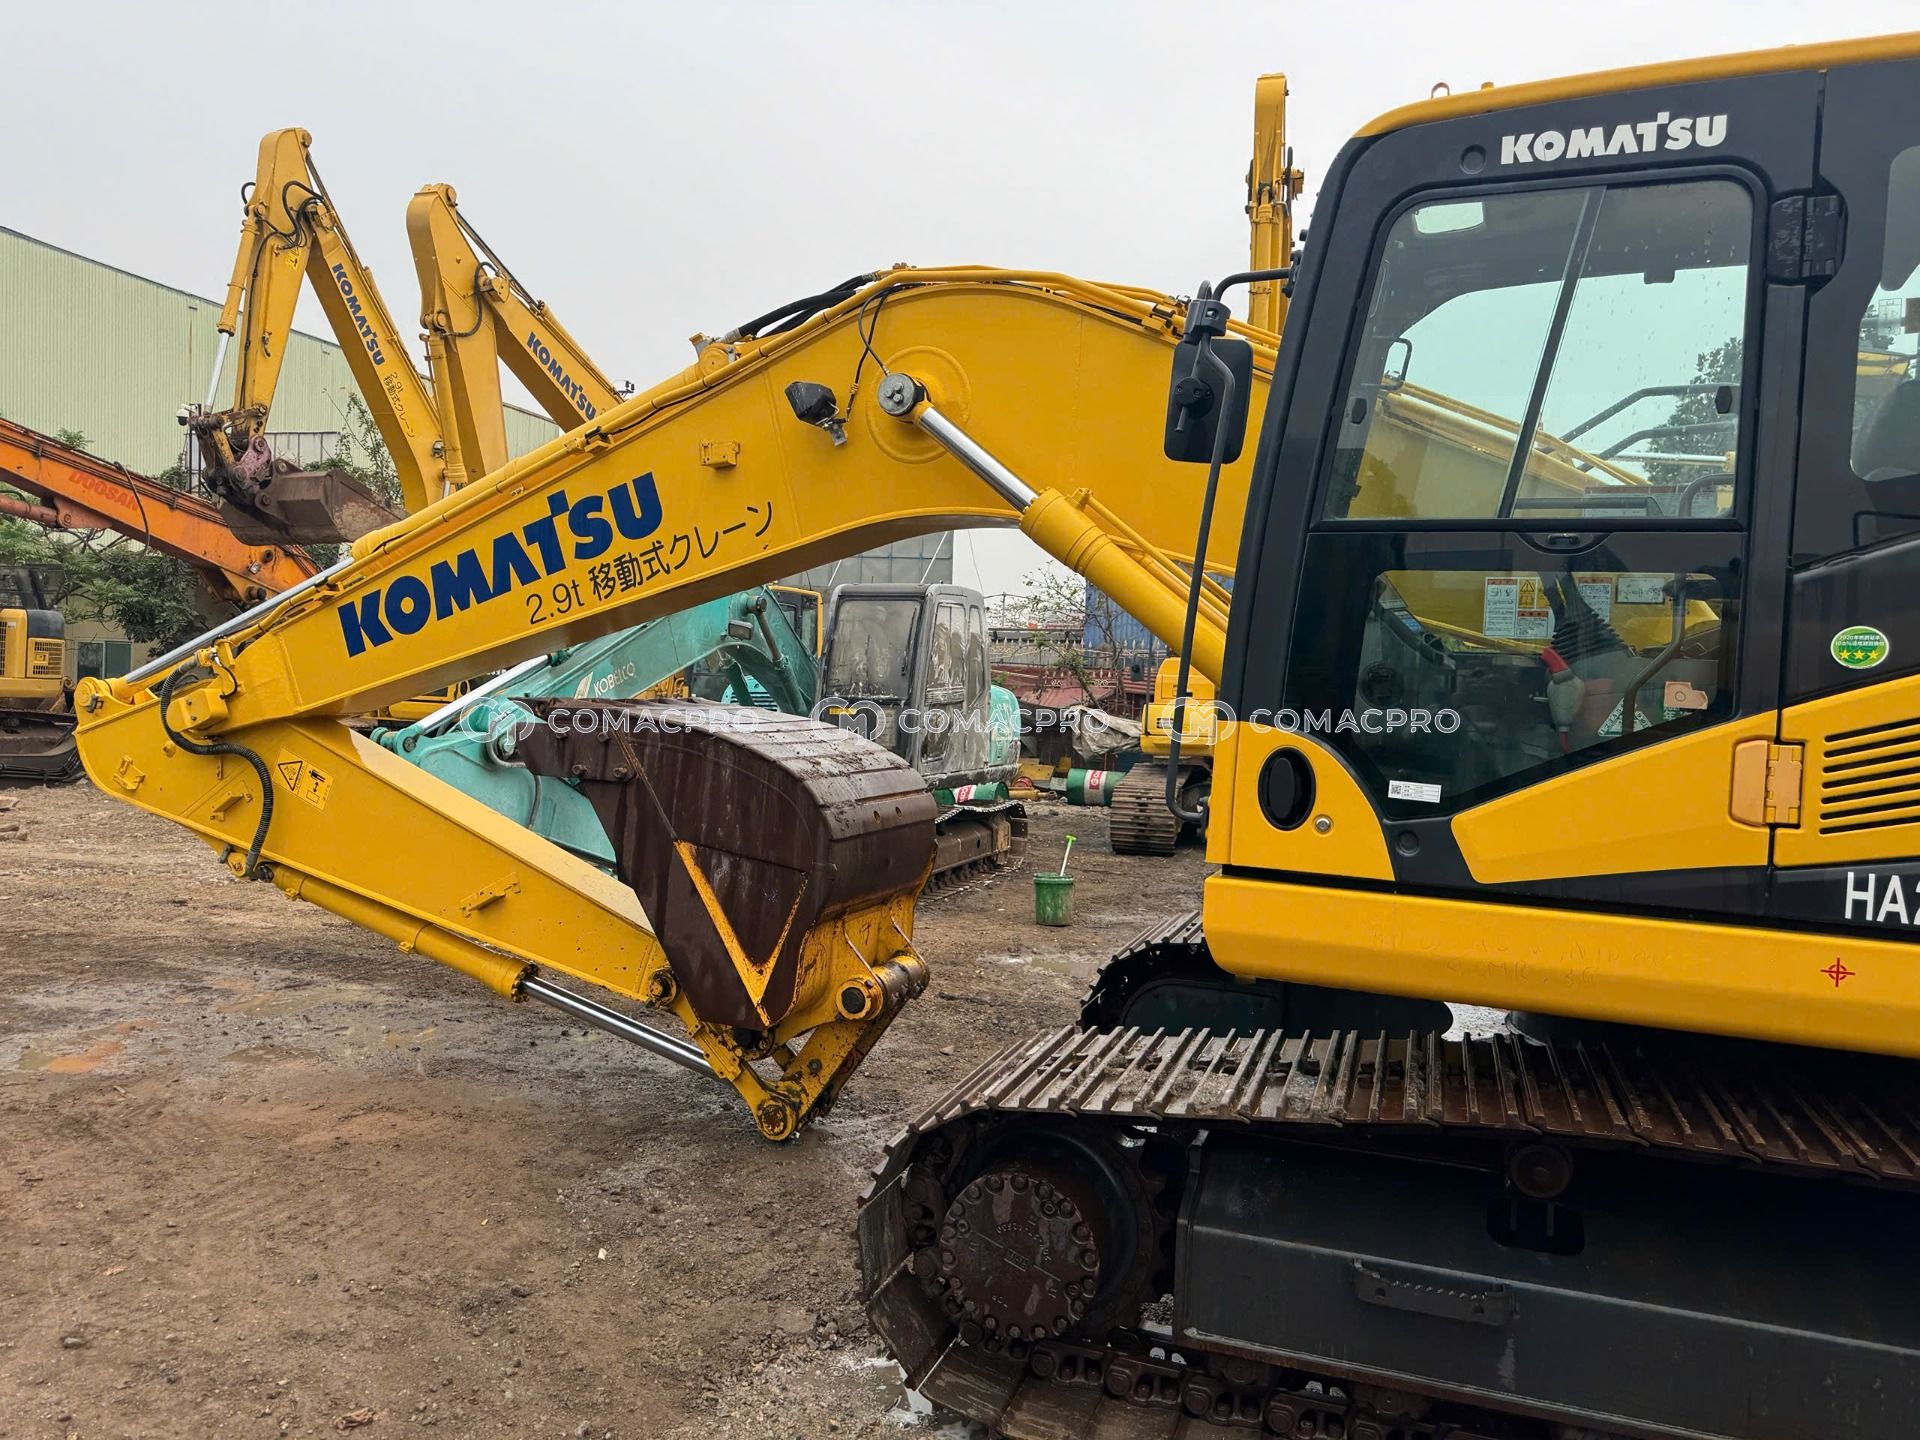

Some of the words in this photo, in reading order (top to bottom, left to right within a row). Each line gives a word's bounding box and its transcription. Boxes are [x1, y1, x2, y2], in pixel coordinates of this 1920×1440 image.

[1500, 111, 1728, 165] KOMATSU
[331, 263, 385, 366] KOMATSU
[526, 331, 597, 420] KOMATSU
[337, 471, 663, 658] KOMATSU
[525, 579, 585, 625] 2.9t
[587, 501, 773, 602] 移動式クレーン
[593, 661, 636, 698] KOBELCO
